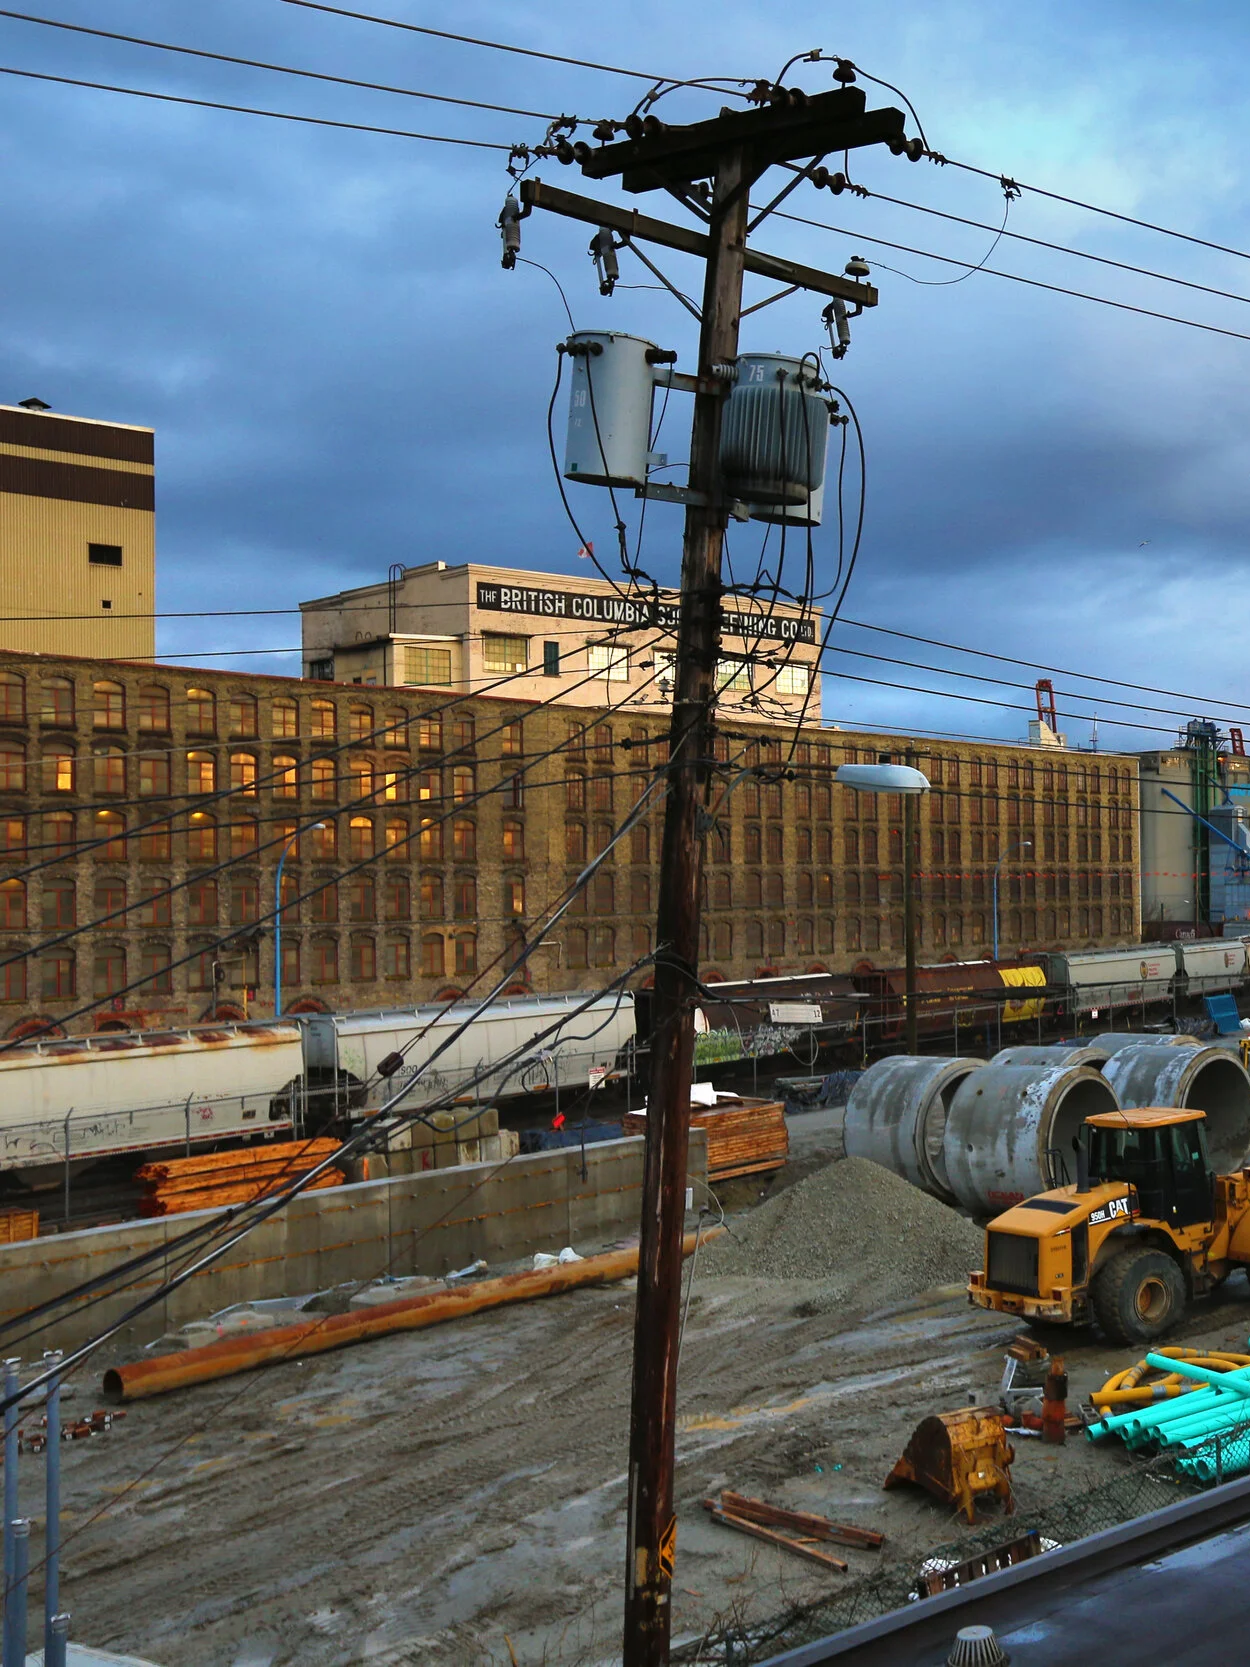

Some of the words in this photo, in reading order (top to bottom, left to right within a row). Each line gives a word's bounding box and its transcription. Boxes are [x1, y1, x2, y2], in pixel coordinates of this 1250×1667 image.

[749, 364, 765, 382] 75
[574, 390, 587, 408] 50
[479, 589, 497, 604] THE
[500, 587, 566, 616] BRITISH
[572, 597, 650, 623] COLUMBIA
[781, 619, 798, 639] CO
[813, 1009, 821, 1018] 12
[400, 1064, 419, 1075] SOO
[1090, 1209, 1106, 1222] 950H
[1108, 1197, 1129, 1219] CAT
